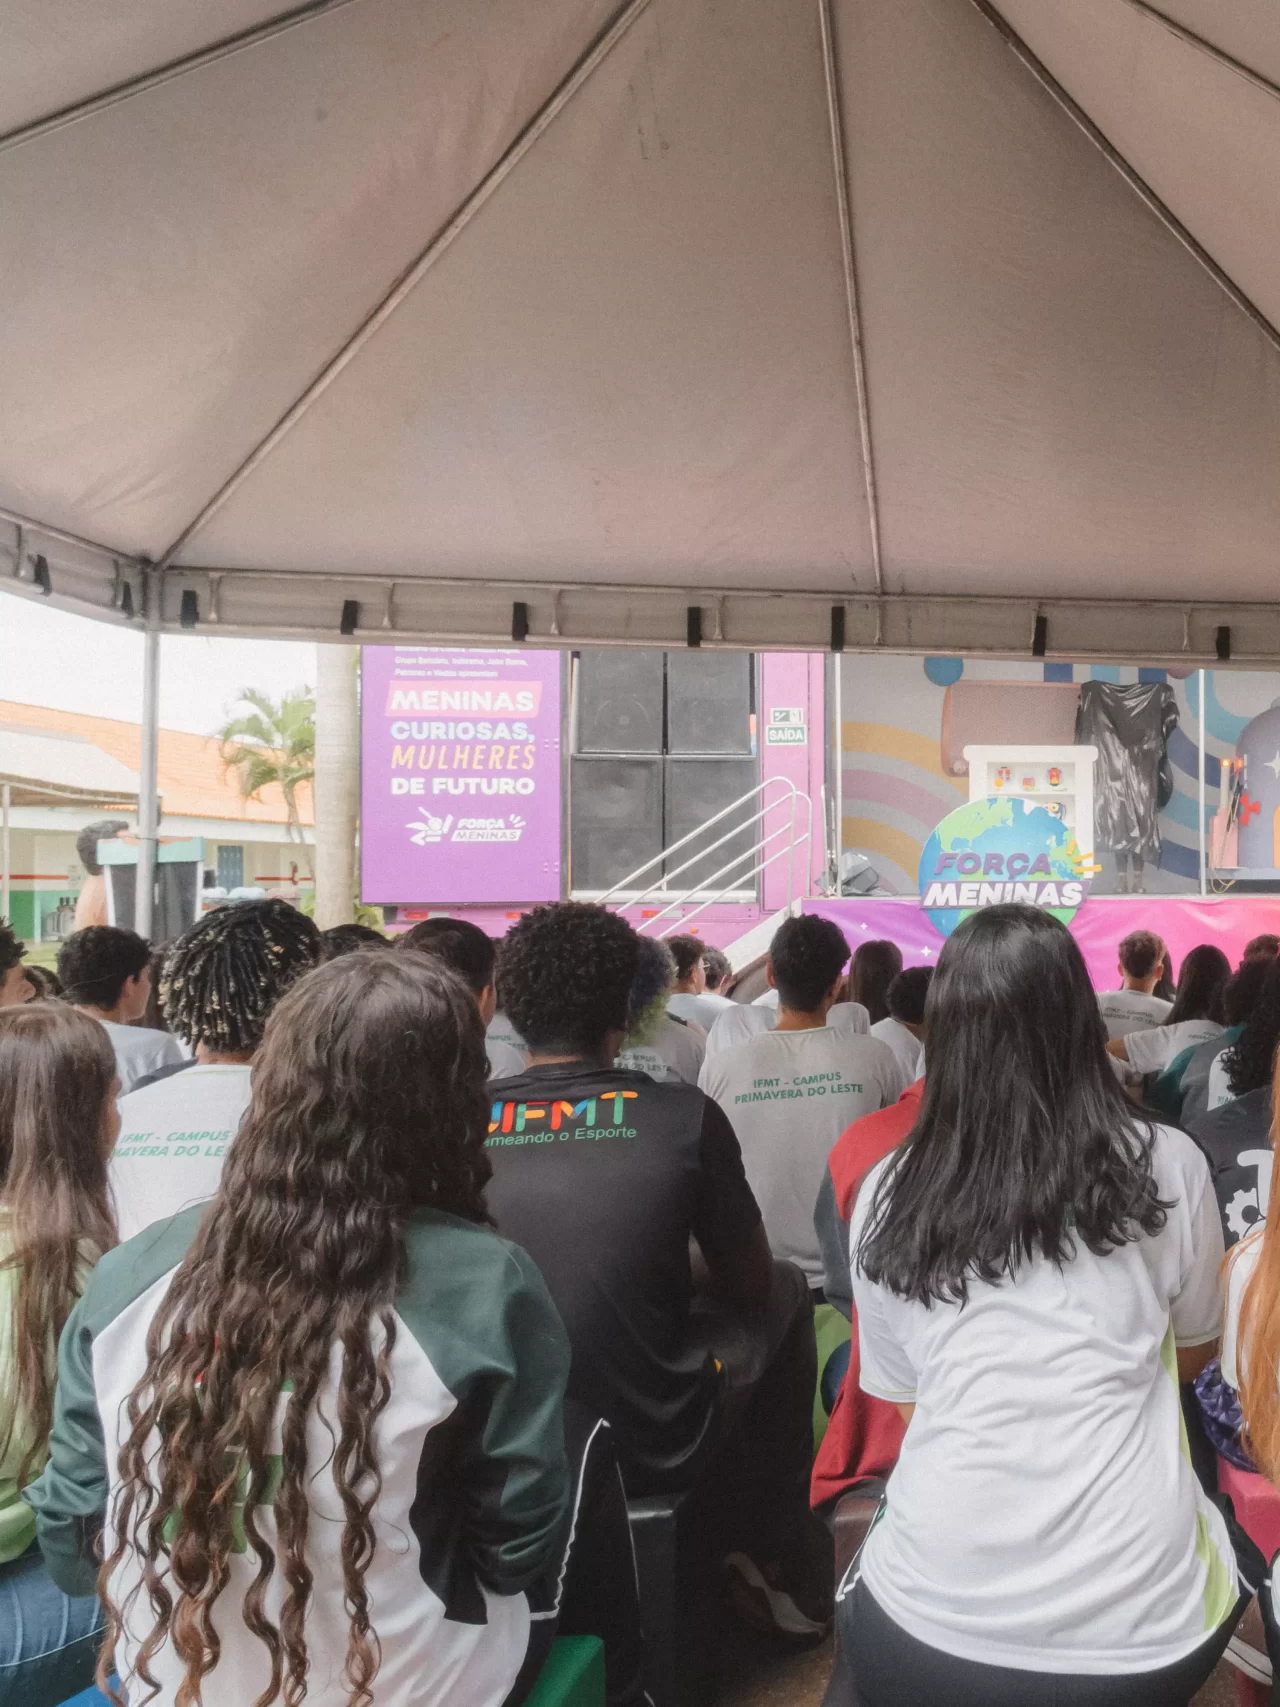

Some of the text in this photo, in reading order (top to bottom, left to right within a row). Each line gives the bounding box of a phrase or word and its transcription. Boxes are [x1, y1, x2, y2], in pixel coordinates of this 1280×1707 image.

[390, 690, 534, 711] MENINAS
[390, 721, 535, 743] CURIOSAS,
[769, 727, 804, 741] SAÍDA
[391, 744, 536, 770] MULHERES
[391, 778, 536, 795] DE FUTURO
[457, 818, 506, 831] FORÇA
[455, 831, 518, 841] MENINAS
[934, 852, 1052, 880] FORÇA
[923, 882, 1083, 907] MENINAS
[754, 1078, 780, 1088] IFMT
[793, 1072, 842, 1086] CAMPUS
[735, 1083, 863, 1104] PRIMAVERA DO LESTE
[167, 1130, 231, 1142] CAMPUS
[559, 1132, 569, 1141] o
[575, 1127, 637, 1141] Esporte
[174, 1146, 200, 1156] DO
